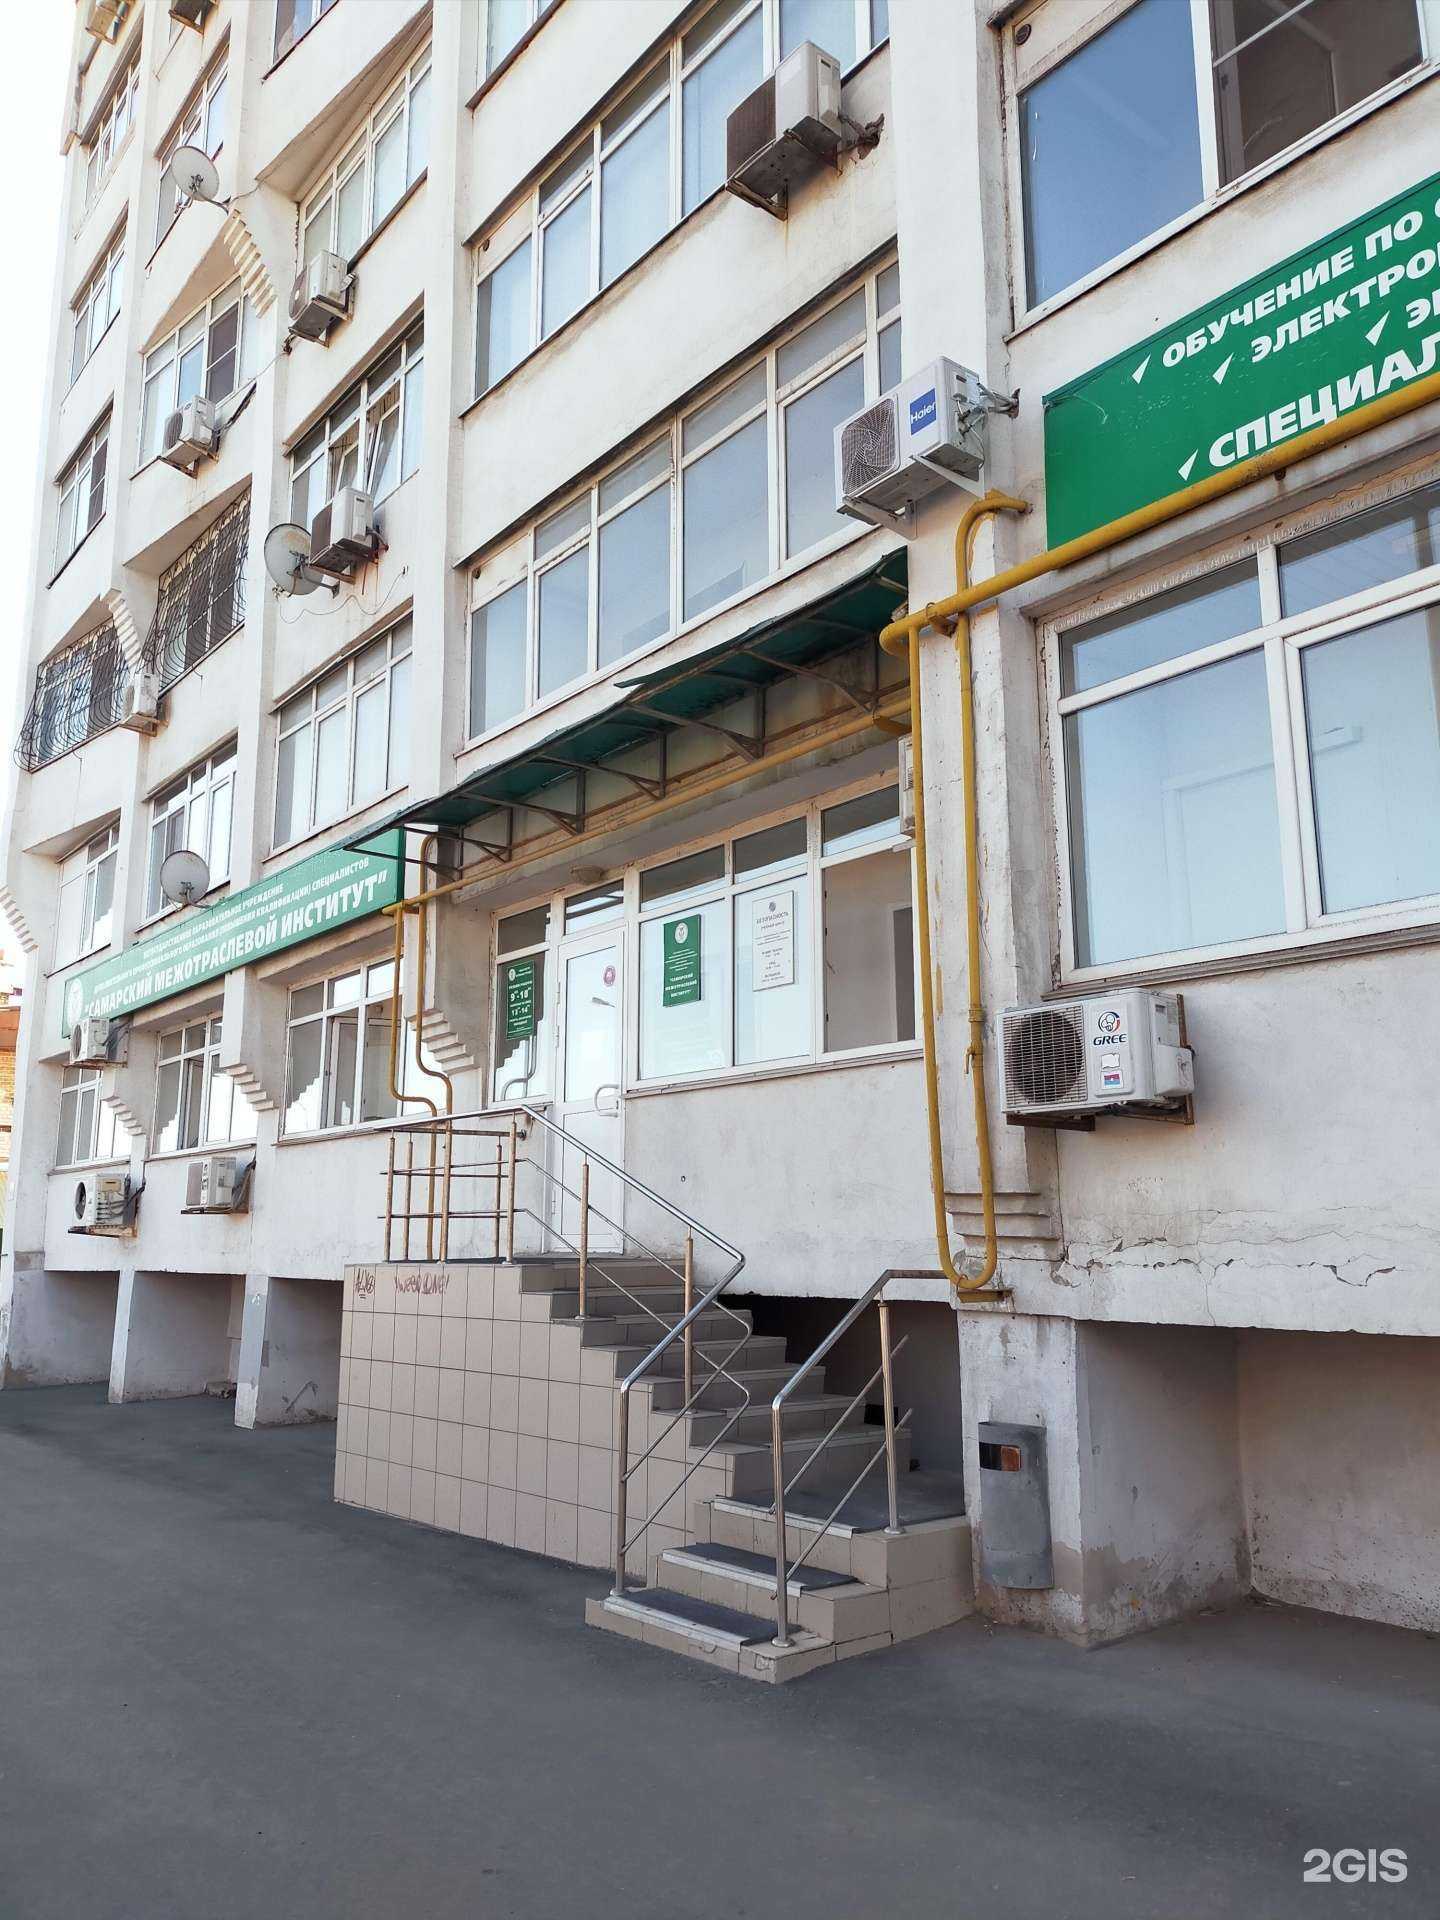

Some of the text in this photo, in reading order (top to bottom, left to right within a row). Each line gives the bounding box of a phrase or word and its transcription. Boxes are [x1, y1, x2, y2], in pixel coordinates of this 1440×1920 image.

[1162, 211, 1423, 368] ОБУЧЕНИЕ ПО
[1251, 241, 1440, 363] ЭЛЕКТРО
[910, 402, 936, 424] Haier
[311, 857, 369, 891] СПЕЦИАЛИСТОВ
[154, 913, 278, 993] МЕЖОТРАСЛЕВОЙ
[1093, 1033, 1127, 1046] GREE
